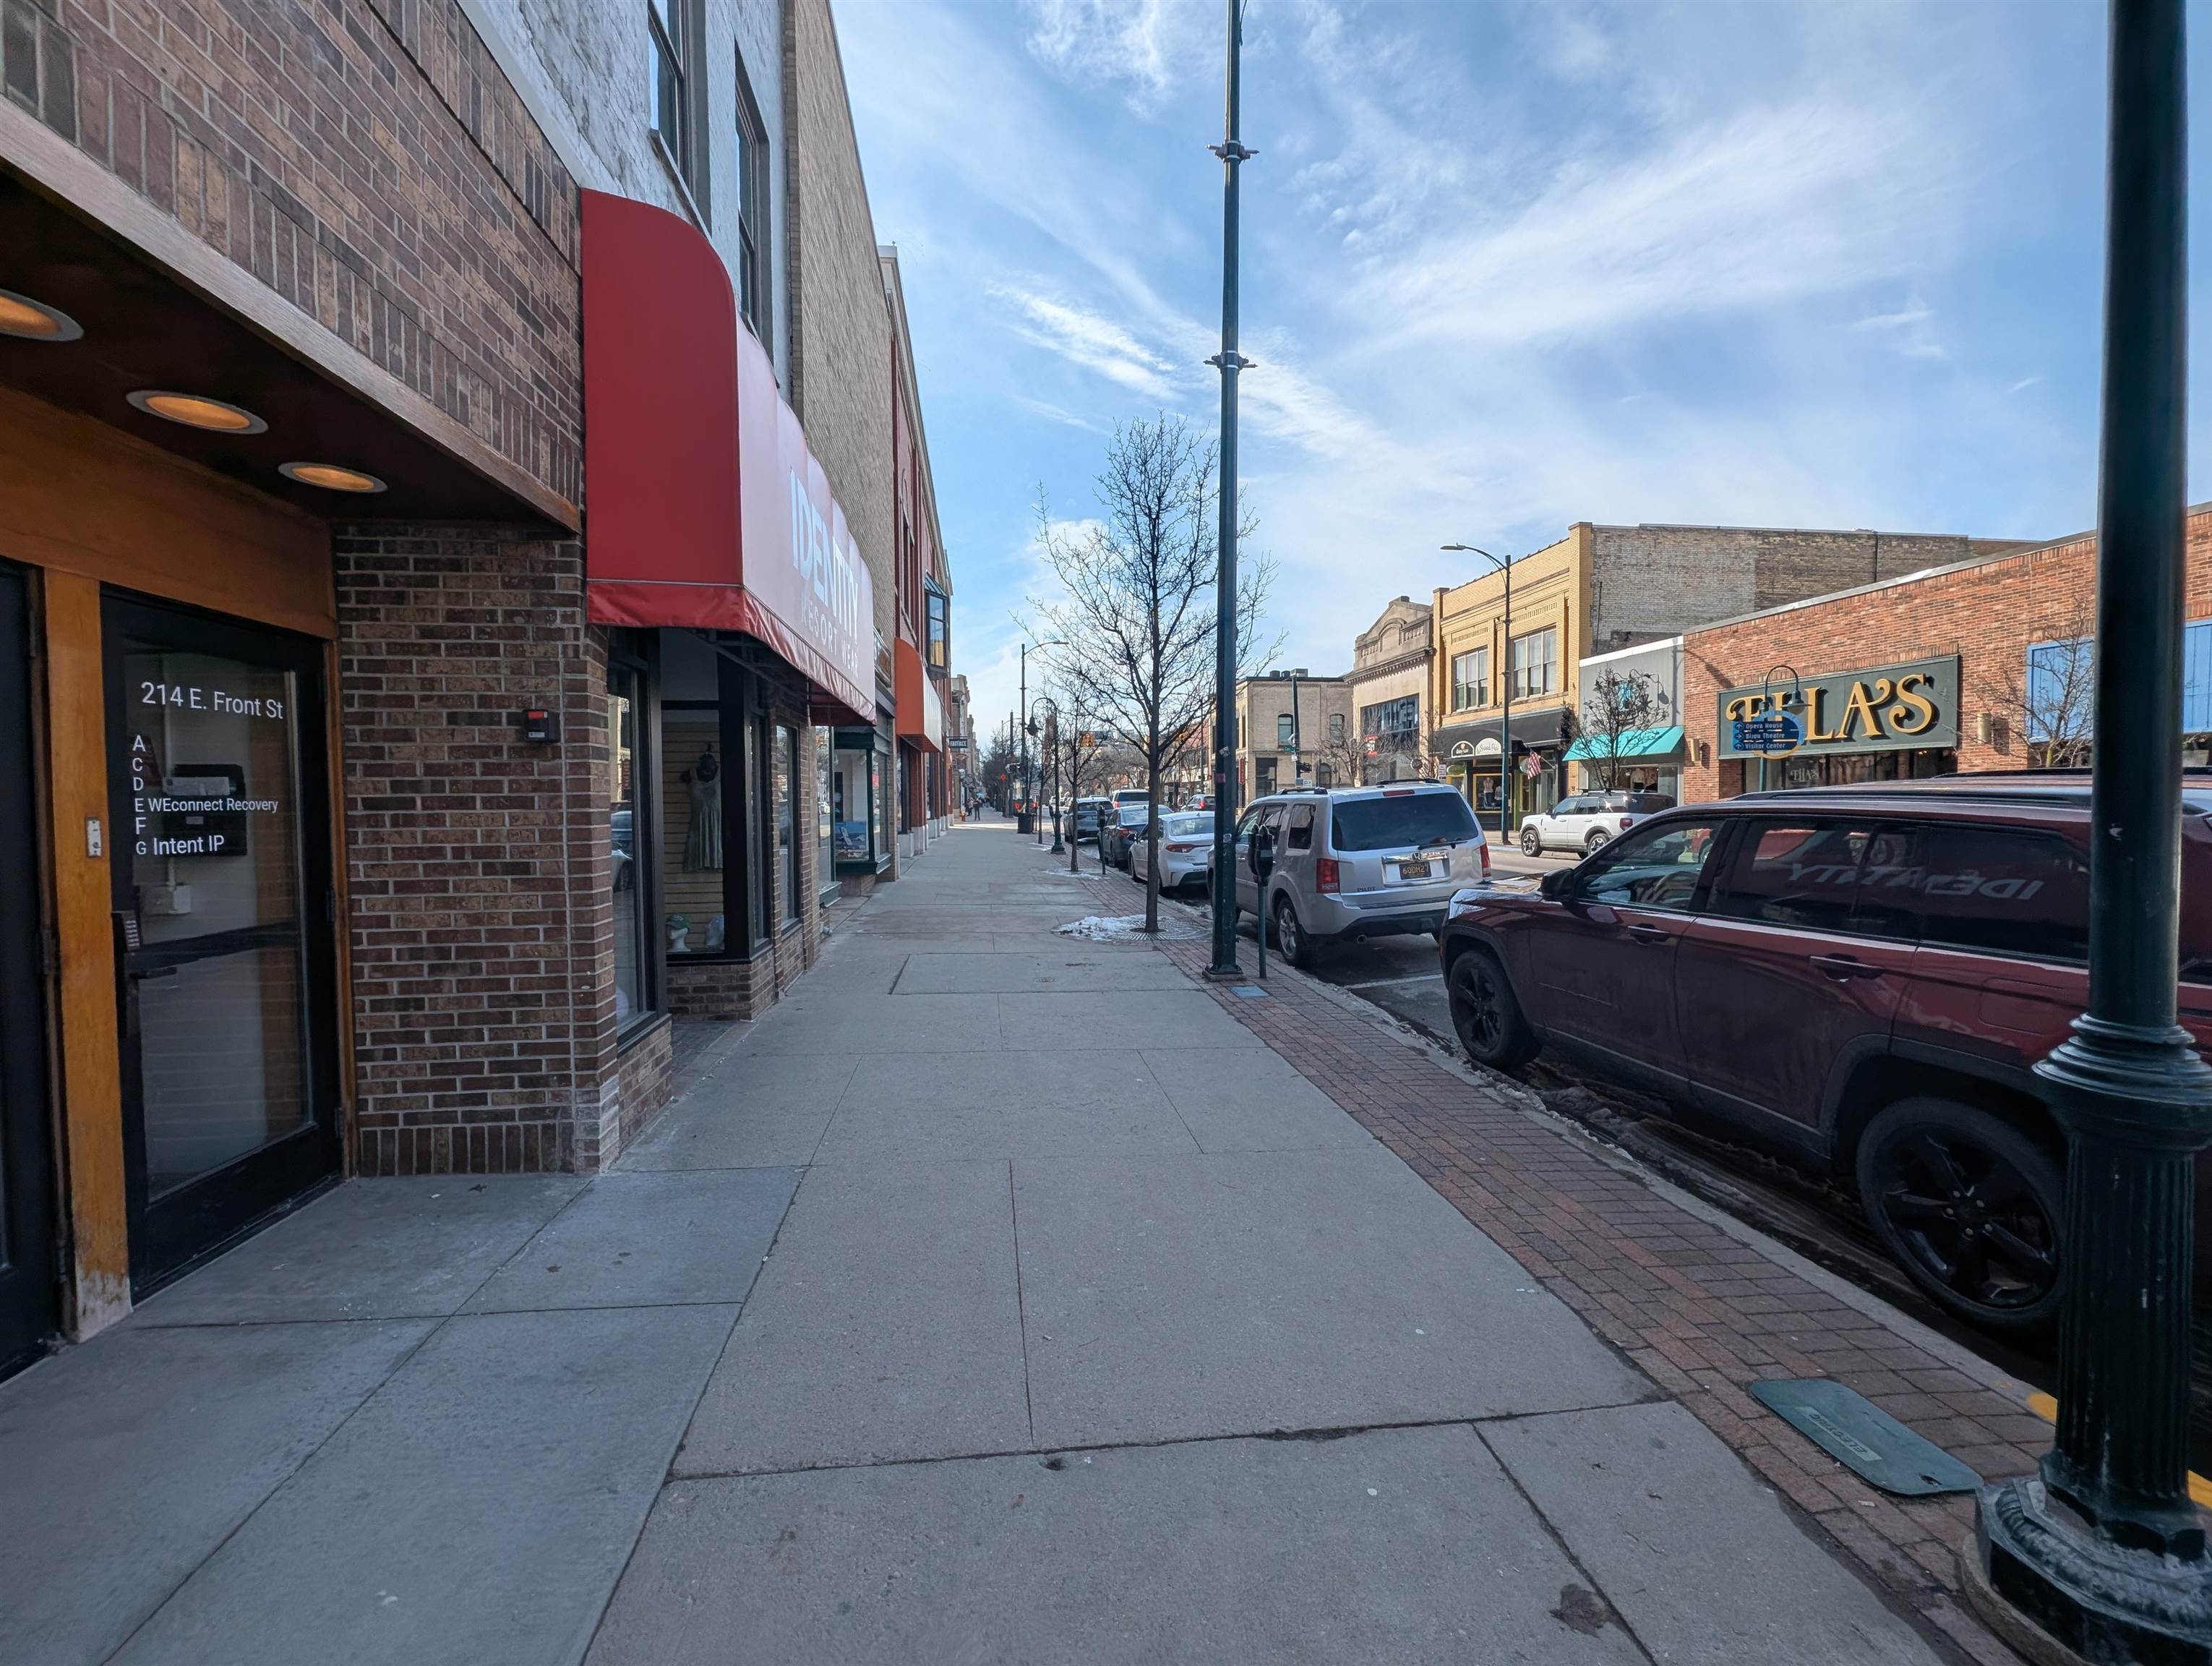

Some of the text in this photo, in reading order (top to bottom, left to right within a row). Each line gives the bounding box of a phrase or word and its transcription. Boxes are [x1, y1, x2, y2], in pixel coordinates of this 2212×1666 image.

[789, 472, 859, 645] IDENTITY
[801, 592, 859, 678] RESORT WEAR
[141, 682, 284, 719] 214 E. Front St
[132, 735, 146, 752] A
[132, 758, 143, 772] C
[133, 777, 144, 791] D
[134, 798, 278, 813] E WEconnect Recovery
[135, 817, 147, 834] F
[136, 835, 225, 855] G Intent IP
[1808, 1414, 1868, 1454] ELECTRIC
